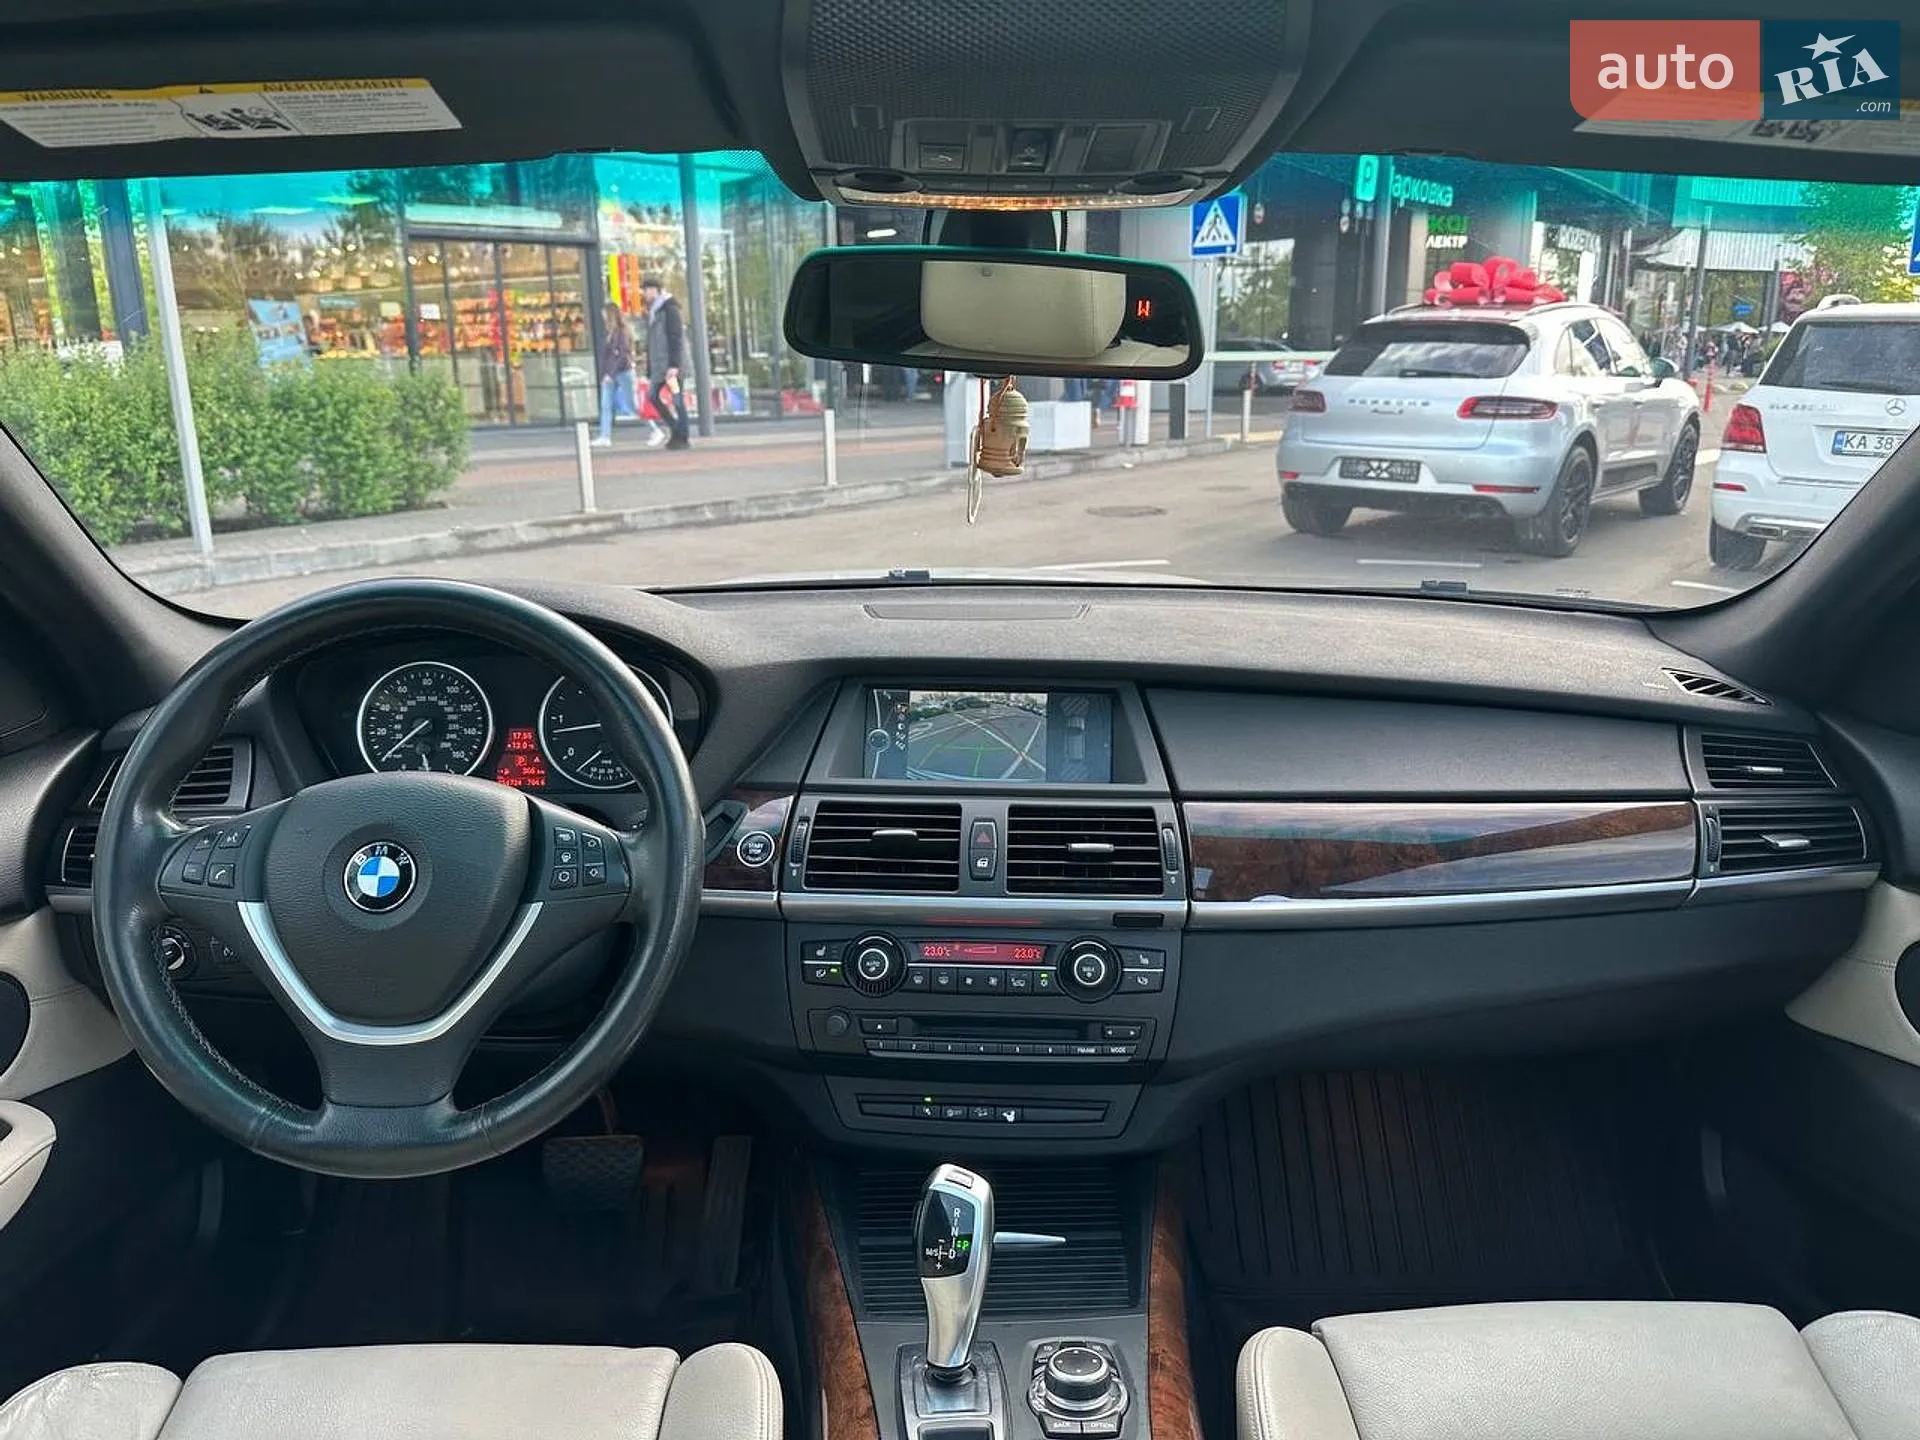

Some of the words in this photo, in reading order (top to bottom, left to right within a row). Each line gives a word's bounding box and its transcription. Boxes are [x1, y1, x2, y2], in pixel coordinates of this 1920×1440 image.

[1137, 300, 1150, 317] W
[1844, 434, 1868, 449] KA
[354, 845, 410, 867] BMW
[953, 1207, 961, 1218] R
[951, 1227, 959, 1237] N
